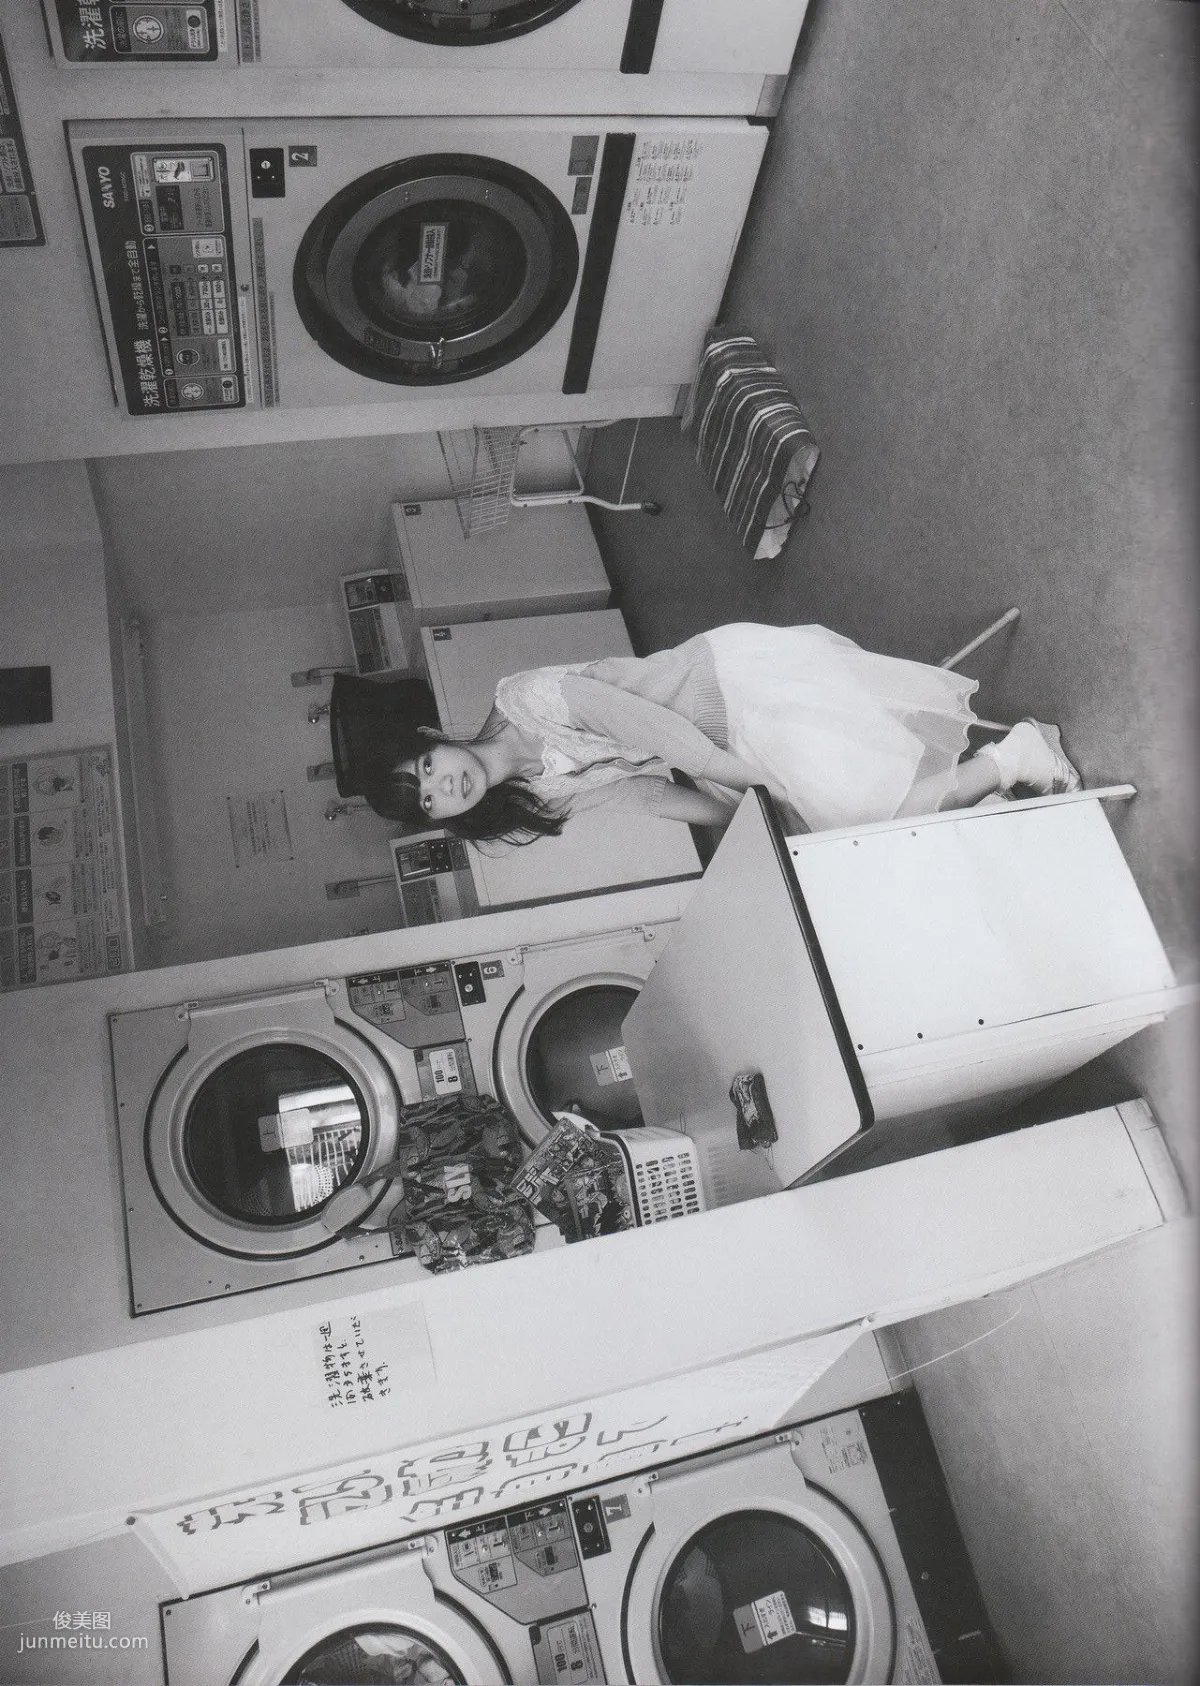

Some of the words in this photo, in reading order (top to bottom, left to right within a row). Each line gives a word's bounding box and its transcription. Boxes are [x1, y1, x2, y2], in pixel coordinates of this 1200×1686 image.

[79, 0, 106, 49] 洗濯
[292, 152, 309, 161] 2
[97, 166, 116, 208] SANYO
[125, 240, 149, 330] 洗濯から乾燥まで全自動
[133, 339, 161, 407] 洗濯乾燥機
[483, 966, 498, 975] 6
[596, 1065, 608, 1075] 下
[434, 1070, 445, 1083] 100
[524, 1511, 535, 1521] 下
[605, 1505, 622, 1517] 7
[475, 1524, 486, 1534] 上
[740, 1623, 755, 1637] 下
[554, 1653, 567, 1673] 100
[570, 1660, 583, 1671] 8
